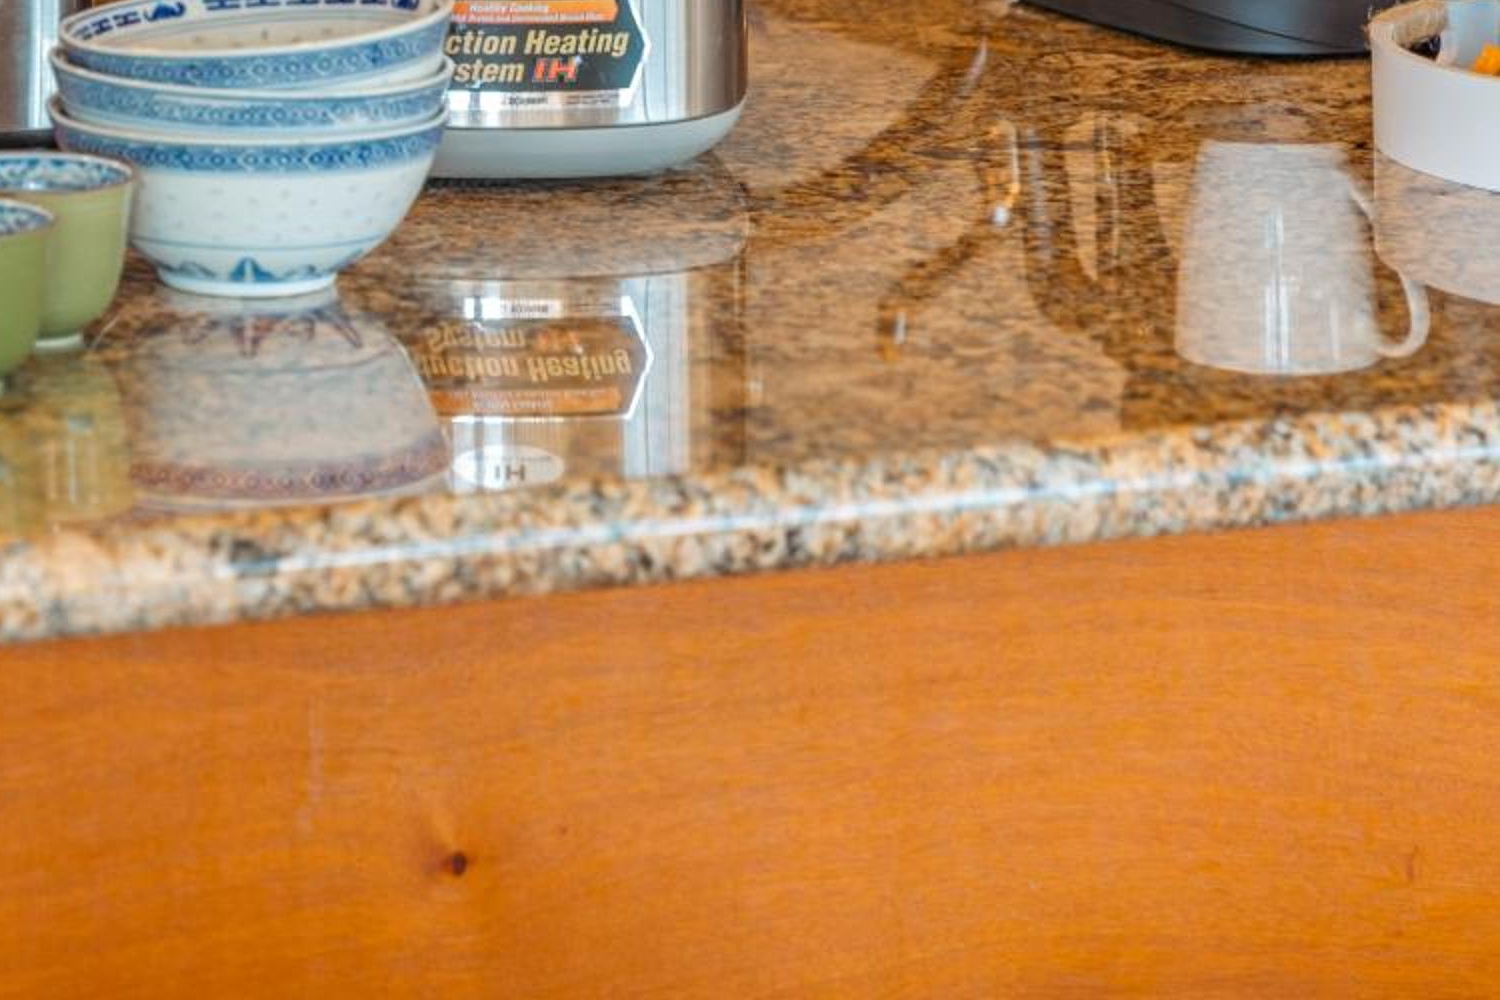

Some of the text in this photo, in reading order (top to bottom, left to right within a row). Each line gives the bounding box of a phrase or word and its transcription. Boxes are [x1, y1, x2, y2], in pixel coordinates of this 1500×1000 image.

[444, 28, 630, 58] ction Heating
[453, 58, 579, 82] stem IH
